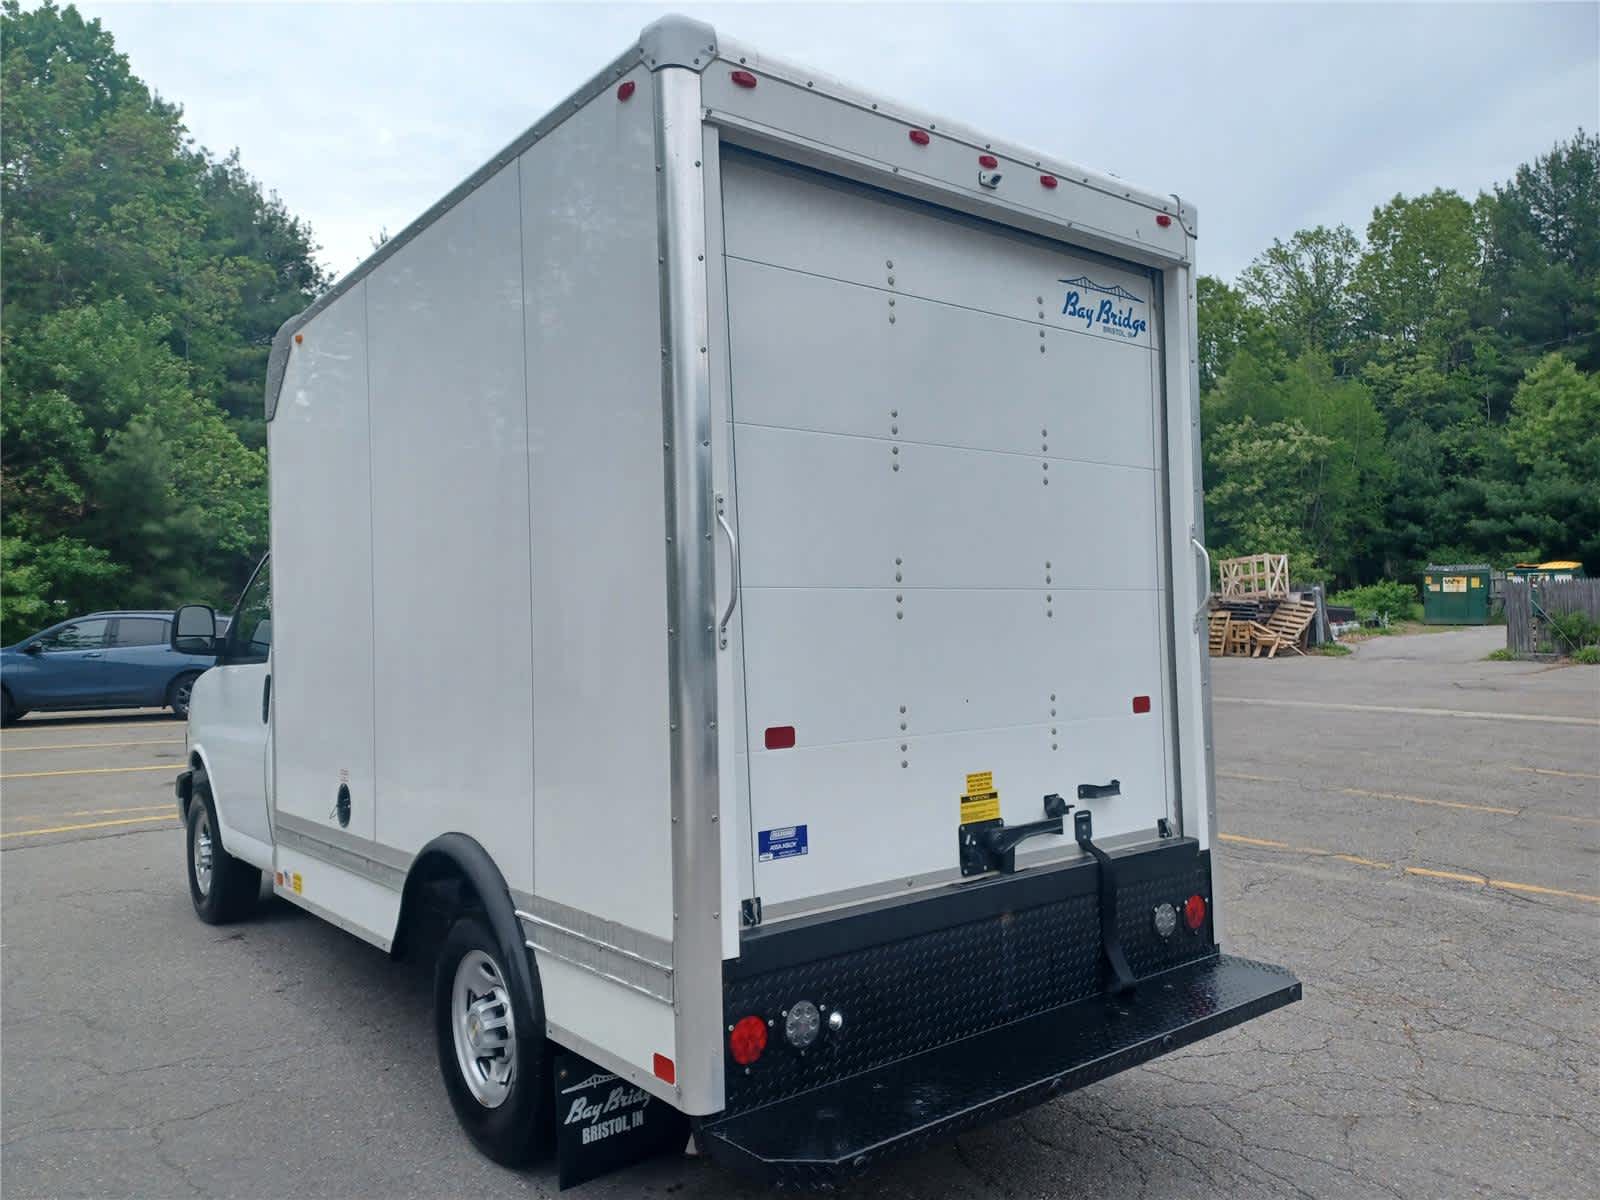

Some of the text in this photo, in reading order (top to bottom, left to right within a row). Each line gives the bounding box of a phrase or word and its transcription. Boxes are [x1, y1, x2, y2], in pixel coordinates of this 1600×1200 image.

[1062, 291, 1146, 337] Bay Bridge
[564, 1086, 651, 1125] Bay Bridg
[632, 1110, 644, 1128] IN
